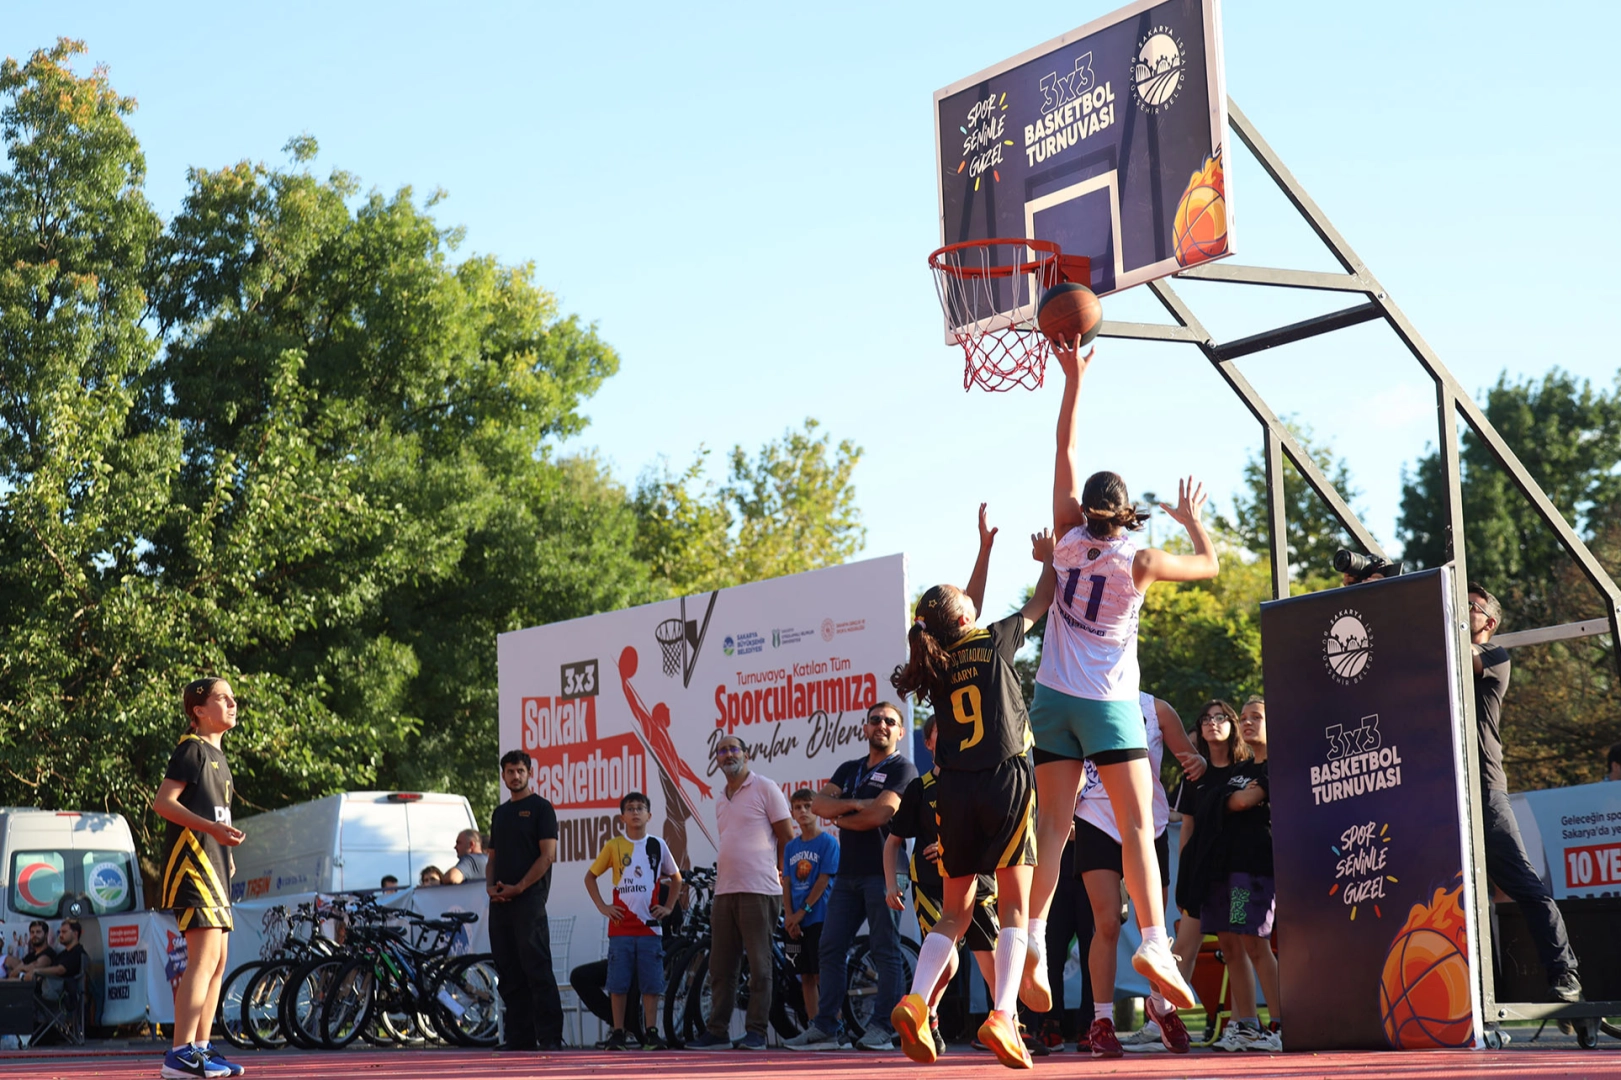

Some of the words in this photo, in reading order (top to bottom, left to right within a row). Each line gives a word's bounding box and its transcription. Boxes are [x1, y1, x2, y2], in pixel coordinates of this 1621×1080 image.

[1138, 25, 1173, 48] SAKARYA
[1040, 51, 1095, 115] 3x3
[967, 93, 996, 128] SPOR
[1024, 82, 1115, 146] BASKETBOL
[963, 115, 1005, 156] SENİNLE
[1026, 106, 1115, 167] TURNUVASI
[969, 143, 1004, 178] GÜZEL
[1064, 568, 1106, 622] 11
[1330, 609, 1362, 625] SAKARYA
[564, 664, 595, 695] 3x3
[736, 668, 786, 686] Turnuvaya
[792, 660, 828, 677] Katılan
[829, 657, 851, 672] Tüm
[951, 666, 979, 684] KARYA
[714, 672, 877, 735] Sporcularımıza
[950, 684, 984, 751] 9
[525, 699, 588, 750] Sokak
[806, 710, 870, 758] Dileri
[1325, 713, 1381, 761] 3x3
[1310, 746, 1402, 786] BASKETBOL
[1312, 767, 1402, 806] TURNUVASI
[1340, 820, 1376, 852] SPOR
[1561, 812, 1605, 826] Geleceğin
[1562, 826, 1609, 839] Sakarya'da
[1335, 847, 1388, 879] SENİNLE
[1568, 850, 1593, 884] 10
[1343, 875, 1385, 905] GÜZEL
